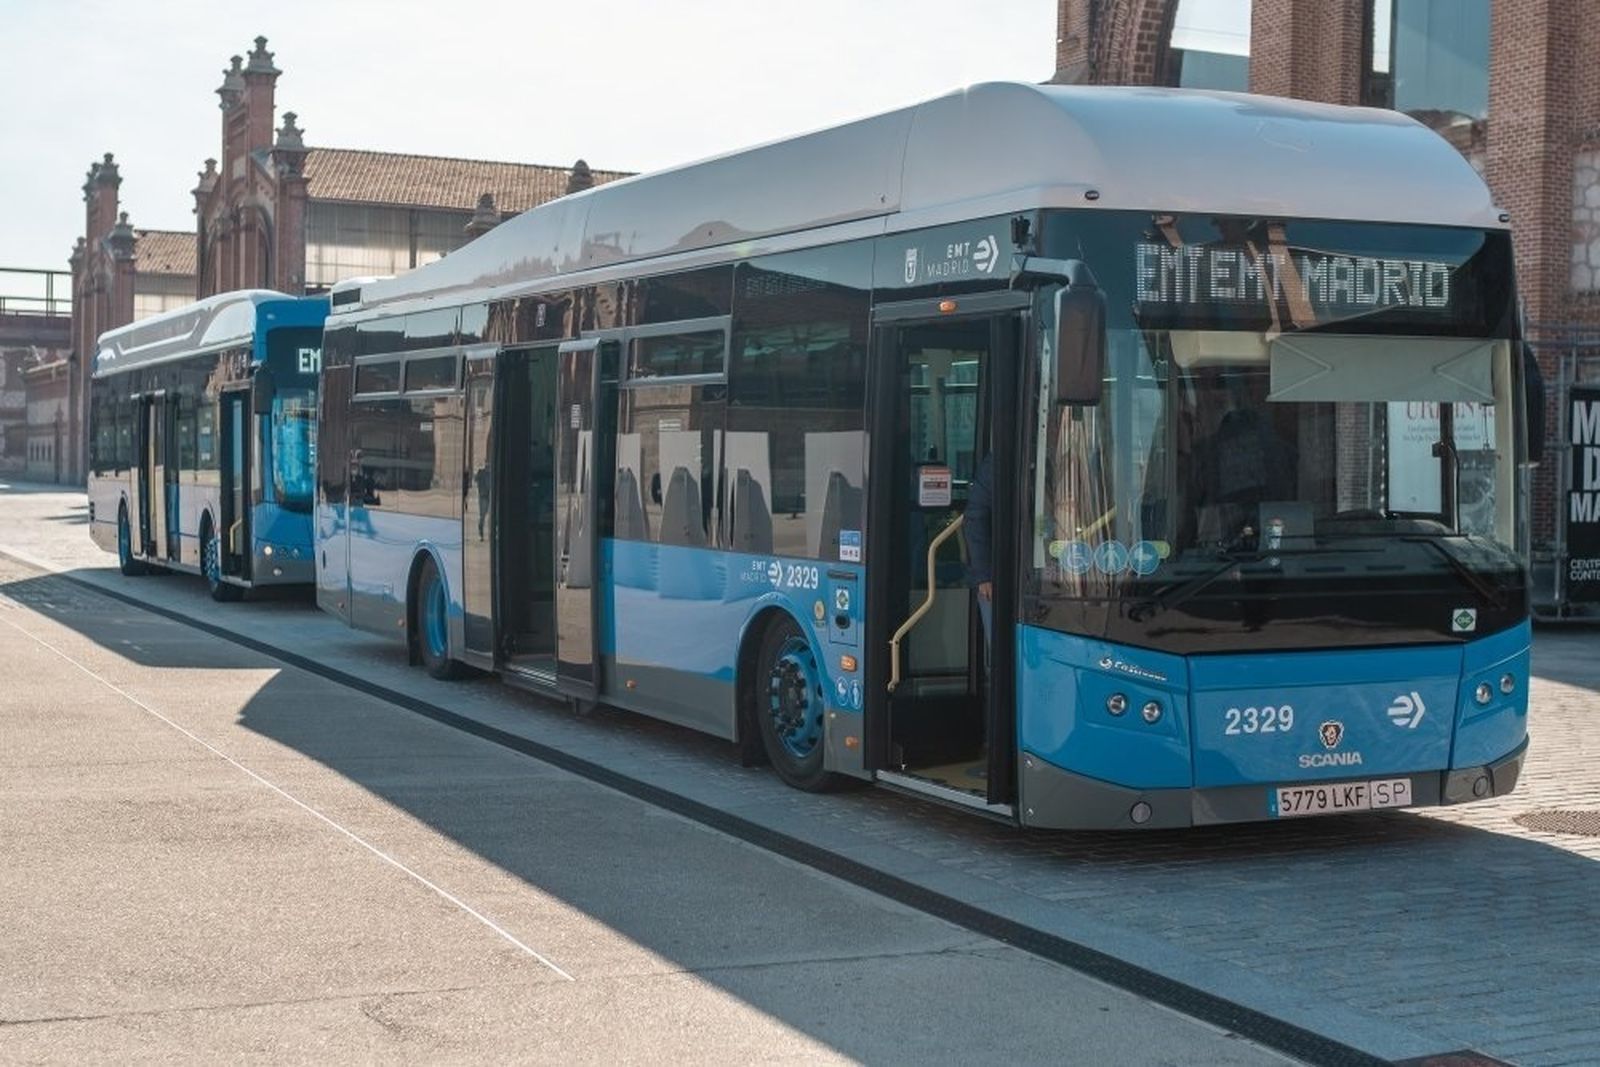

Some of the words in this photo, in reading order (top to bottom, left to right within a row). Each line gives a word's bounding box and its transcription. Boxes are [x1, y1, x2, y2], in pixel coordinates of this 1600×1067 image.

[947, 242, 970, 259] EMT
[927, 258, 969, 277] MADRID
[1137, 243, 1204, 303] EMT
[1210, 249, 1285, 300] EMT
[1302, 254, 1448, 307] MADRID
[752, 560, 766, 571] EMT
[786, 565, 819, 589] 2329
[1225, 705, 1294, 735] 2329
[1299, 752, 1362, 768] SCANIA
[1281, 789, 1328, 812] 5779
[1332, 786, 1365, 808] LKF
